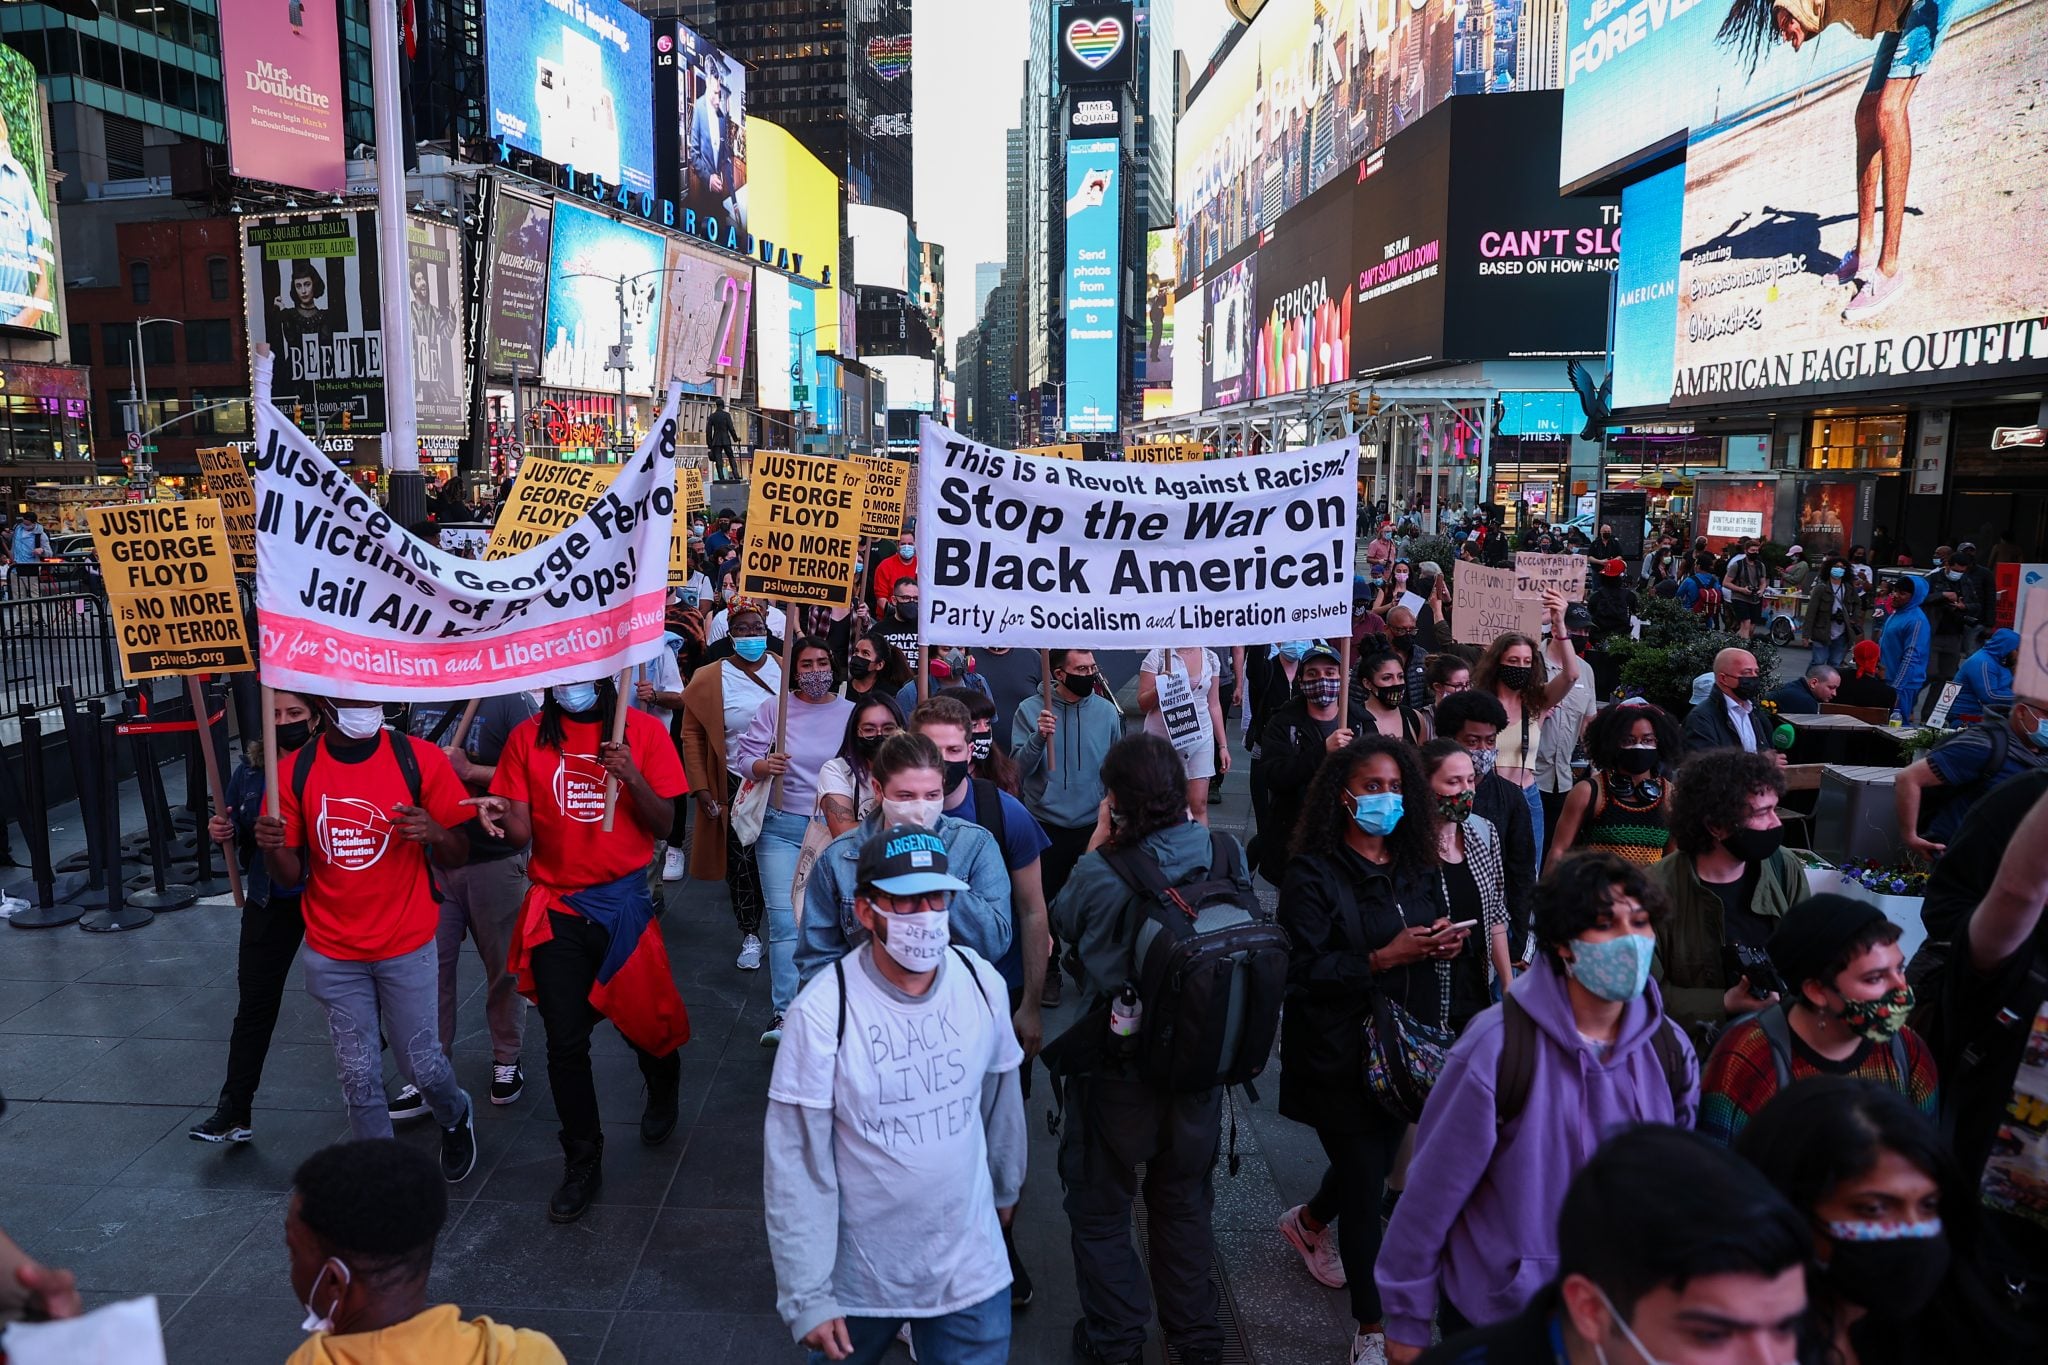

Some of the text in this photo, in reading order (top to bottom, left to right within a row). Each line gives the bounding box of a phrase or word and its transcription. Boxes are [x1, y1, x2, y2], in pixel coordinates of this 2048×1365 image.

[256, 59, 292, 81] Mrs.
[658, 55, 672, 66] LG
[245, 71, 329, 108] Doubtfire
[252, 105, 282, 119] Previews
[282, 112, 301, 124] begin
[302, 117, 322, 128] March
[1073, 112, 1117, 123] SQUARE
[1079, 102, 1112, 112] TIMES
[565, 163, 651, 218] 1540
[250, 222, 346, 241] TIMES SQUARE CAN REALLY
[663, 200, 803, 273] BROADWAY
[269, 240, 354, 257] MAKE YOU FEEL ALIVE!
[1078, 249, 1106, 260] Send
[1384, 235, 1410, 260] THIS PLAN
[1480, 229, 1570, 258] CAN'T
[498, 250, 543, 274] INSUREARTH
[1360, 239, 1439, 291] CAN'T SLOW YOU DOWN
[1692, 245, 1732, 267] Featuring
[1074, 266, 1111, 278] photos
[1479, 261, 1523, 276] BASED
[1526, 260, 1547, 274] ON
[1551, 259, 1584, 273] HOW
[1079, 281, 1104, 291] from
[1620, 280, 1674, 307] AMERICAN
[1069, 297, 1114, 310] phones
[1274, 276, 1327, 322] SEPHORA
[718, 276, 751, 368] 21
[1086, 314, 1098, 323] to
[1070, 328, 1113, 339] frames
[522, 342, 532, 350] plan
[1673, 352, 1793, 398] AMERICAN
[1801, 339, 1893, 383] EAGLE
[316, 383, 325, 391] The
[351, 381, 360, 390] The
[1537, 419, 1549, 429] IN
[423, 438, 459, 450] LUGGAGE
[1130, 446, 1200, 463] JUSTICE for
[208, 472, 247, 491] GEORGE
[524, 462, 594, 490] JUSTICE
[760, 456, 860, 487] JUSTICE for
[896, 466, 906, 475] for
[944, 441, 1350, 500] This is a Revolt Against Racism!
[520, 485, 594, 513] GEORGE
[762, 481, 853, 509] GEORGE
[1863, 486, 1872, 521] Newsstand
[255, 429, 590, 593] Justice George
[517, 505, 579, 529] FLOYD
[770, 504, 839, 529] FLOYD
[872, 500, 901, 513] MORE
[937, 477, 1064, 544] Stop
[1084, 500, 1169, 541] the
[1184, 501, 1277, 540] War
[1285, 495, 1345, 532] on
[100, 507, 215, 536] JUSTICE for
[866, 511, 900, 525] TERROR
[1726, 516, 1735, 524] PLAY
[1736, 516, 1746, 524] WITH
[111, 535, 216, 563] GEORGE
[494, 533, 507, 546] is
[508, 530, 532, 550] NO
[751, 531, 851, 558] is NO MORE
[294, 500, 436, 597] Victims
[449, 598, 494, 621] of
[748, 551, 849, 581] COP TERROR
[934, 538, 1344, 595] Black America!
[128, 562, 208, 587] FLOYD
[1549, 568, 1563, 576] NOT
[300, 547, 637, 636] Jail All Cops!
[763, 579, 829, 598] pslweb.org
[1517, 577, 1578, 593] JUSTICE
[121, 592, 233, 620] is NO MORE
[1458, 589, 1484, 608] BUT
[930, 600, 1348, 634] Party for Socialism and Liberation @pslweb
[1479, 611, 1520, 630] SYSTEM
[124, 619, 241, 647] COP TERROR
[150, 651, 224, 669] pslweb.org
[287, 630, 319, 662] for
[324, 637, 438, 677] Socialism
[446, 653, 484, 674] and
[489, 623, 613, 671] Liberation
[1161, 692, 1191, 708] MUST STOP!
[1167, 708, 1191, 722] We Need
[1169, 720, 1198, 735] Revolution
[567, 781, 589, 791] Party
[567, 791, 603, 799] Socialism
[567, 800, 605, 809] Liberation
[331, 827, 354, 837] Party
[332, 837, 371, 847] Socialism
[333, 847, 374, 857] Liberation
[867, 1008, 960, 1065] BLACK
[878, 1049, 966, 1105] LIVES
[862, 1095, 973, 1149] MATTER
